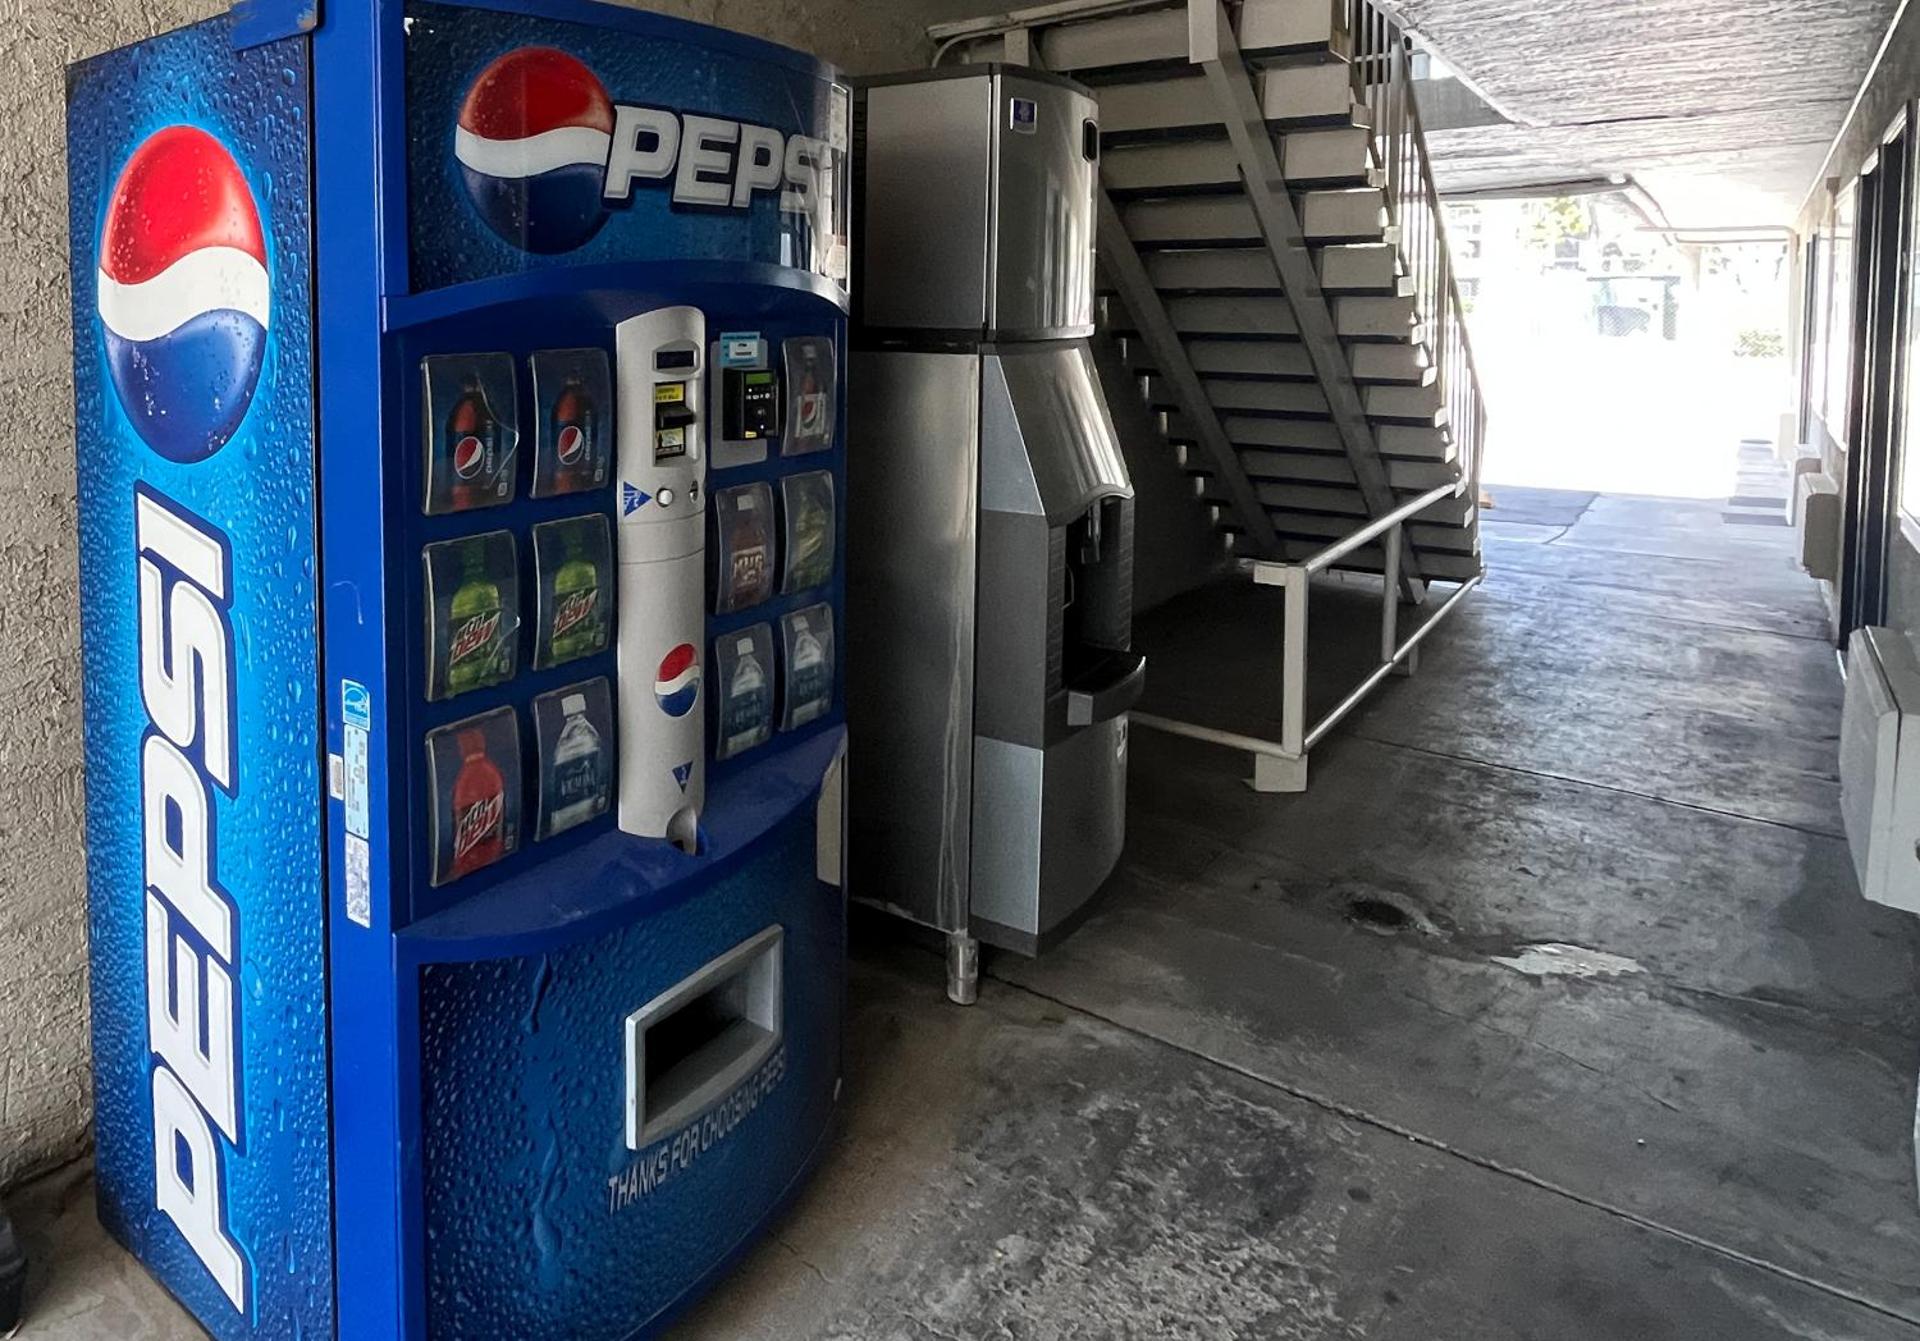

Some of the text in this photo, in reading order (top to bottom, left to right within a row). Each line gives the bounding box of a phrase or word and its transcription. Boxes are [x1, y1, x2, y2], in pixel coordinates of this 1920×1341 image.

[604, 104, 832, 214] PEPS
[136, 490, 244, 1315] PEPSI
[608, 1145, 669, 1215] THANKS
[671, 1123, 700, 1174] FOR
[760, 1047, 784, 1104] PEPS
